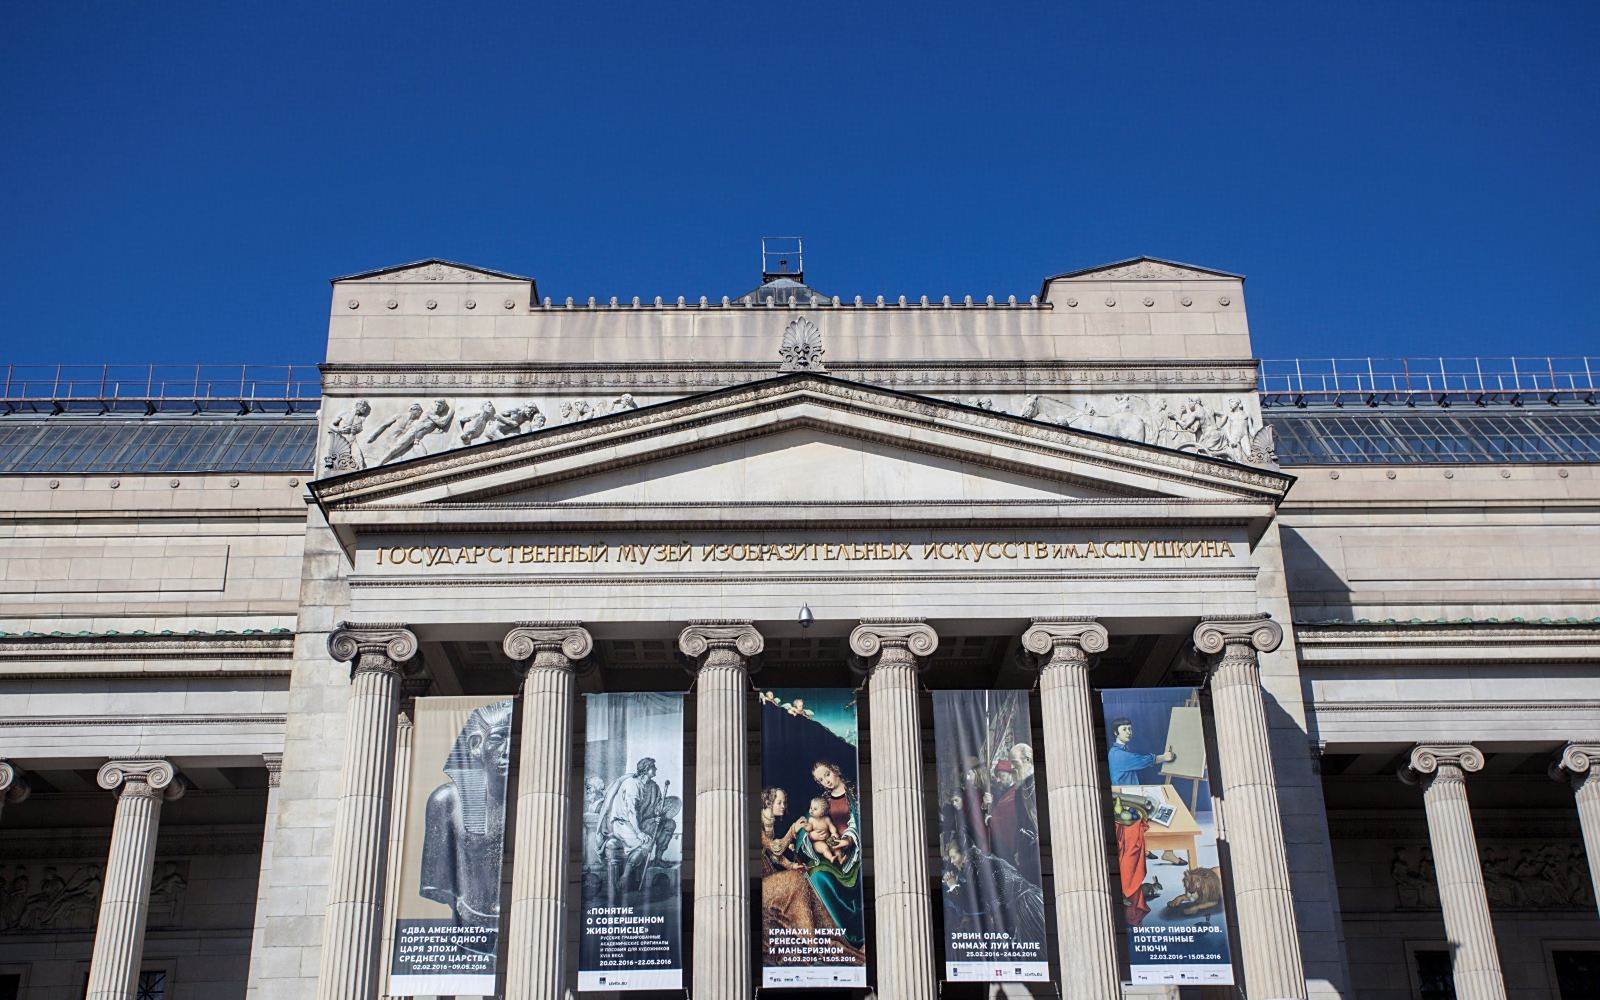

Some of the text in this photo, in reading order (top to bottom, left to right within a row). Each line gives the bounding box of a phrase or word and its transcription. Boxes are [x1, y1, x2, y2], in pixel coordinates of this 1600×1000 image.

[376, 542, 609, 566] ГОСУДАРСТВЕННЫЙ
[616, 541, 692, 565] МУЗЕЙ
[701, 542, 912, 562] ИЗОБРАЗИТЕЛЬНЫХ
[923, 541, 1048, 562] ИСКУССТВ
[587, 907, 634, 915] «ПОНЯТИЕ
[586, 916, 665, 925] О СОВЕРШЕННОМ
[402, 926, 425, 934] «ДВА
[586, 926, 649, 935] ЖИВОПИСЦЕ»
[769, 928, 846, 936] КРАНАХИ. МЕЖДУ
[1133, 926, 1166, 934] ВИКТОР
[451, 935, 487, 944] ОДНОГО
[951, 932, 1012, 940] ЭРВИН ОЛАФ.
[1134, 935, 1195, 943] ПОТЕРЯННЫЕ
[769, 937, 831, 945] РЕНЕССАНСОМ
[400, 945, 458, 954] ЦАРЯ ЭПОХИ
[951, 942, 988, 950] ОММАЖ
[990, 942, 1009, 950] ЛУИ
[399, 954, 490, 963] СРЕДНЕГО ЦАРСТВА
